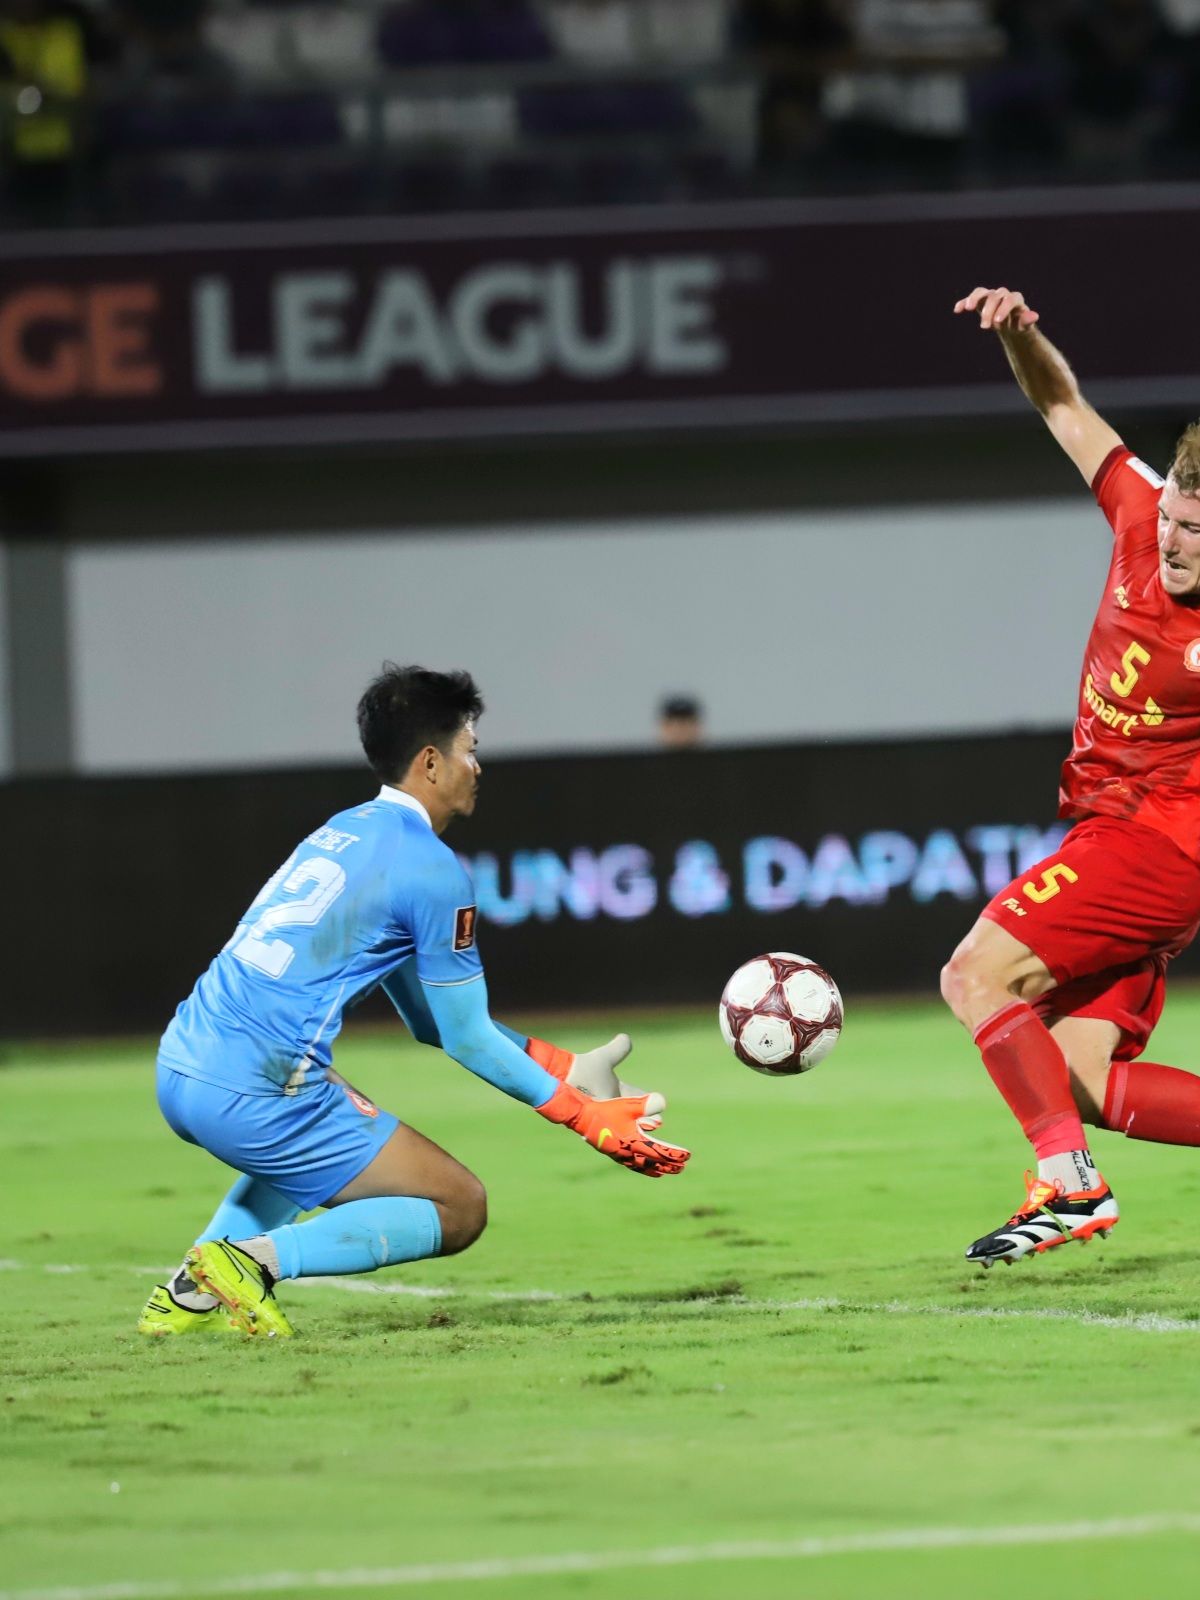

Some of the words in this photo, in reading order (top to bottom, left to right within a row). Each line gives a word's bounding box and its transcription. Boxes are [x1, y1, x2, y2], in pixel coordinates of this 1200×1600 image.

[0, 280, 161, 395] GE
[194, 253, 728, 392] LEAGUE
[1110, 641, 1151, 698] 5
[1083, 673, 1139, 737] smart
[457, 842, 660, 924] UNG
[668, 837, 731, 916] &
[1022, 863, 1079, 904] 5
